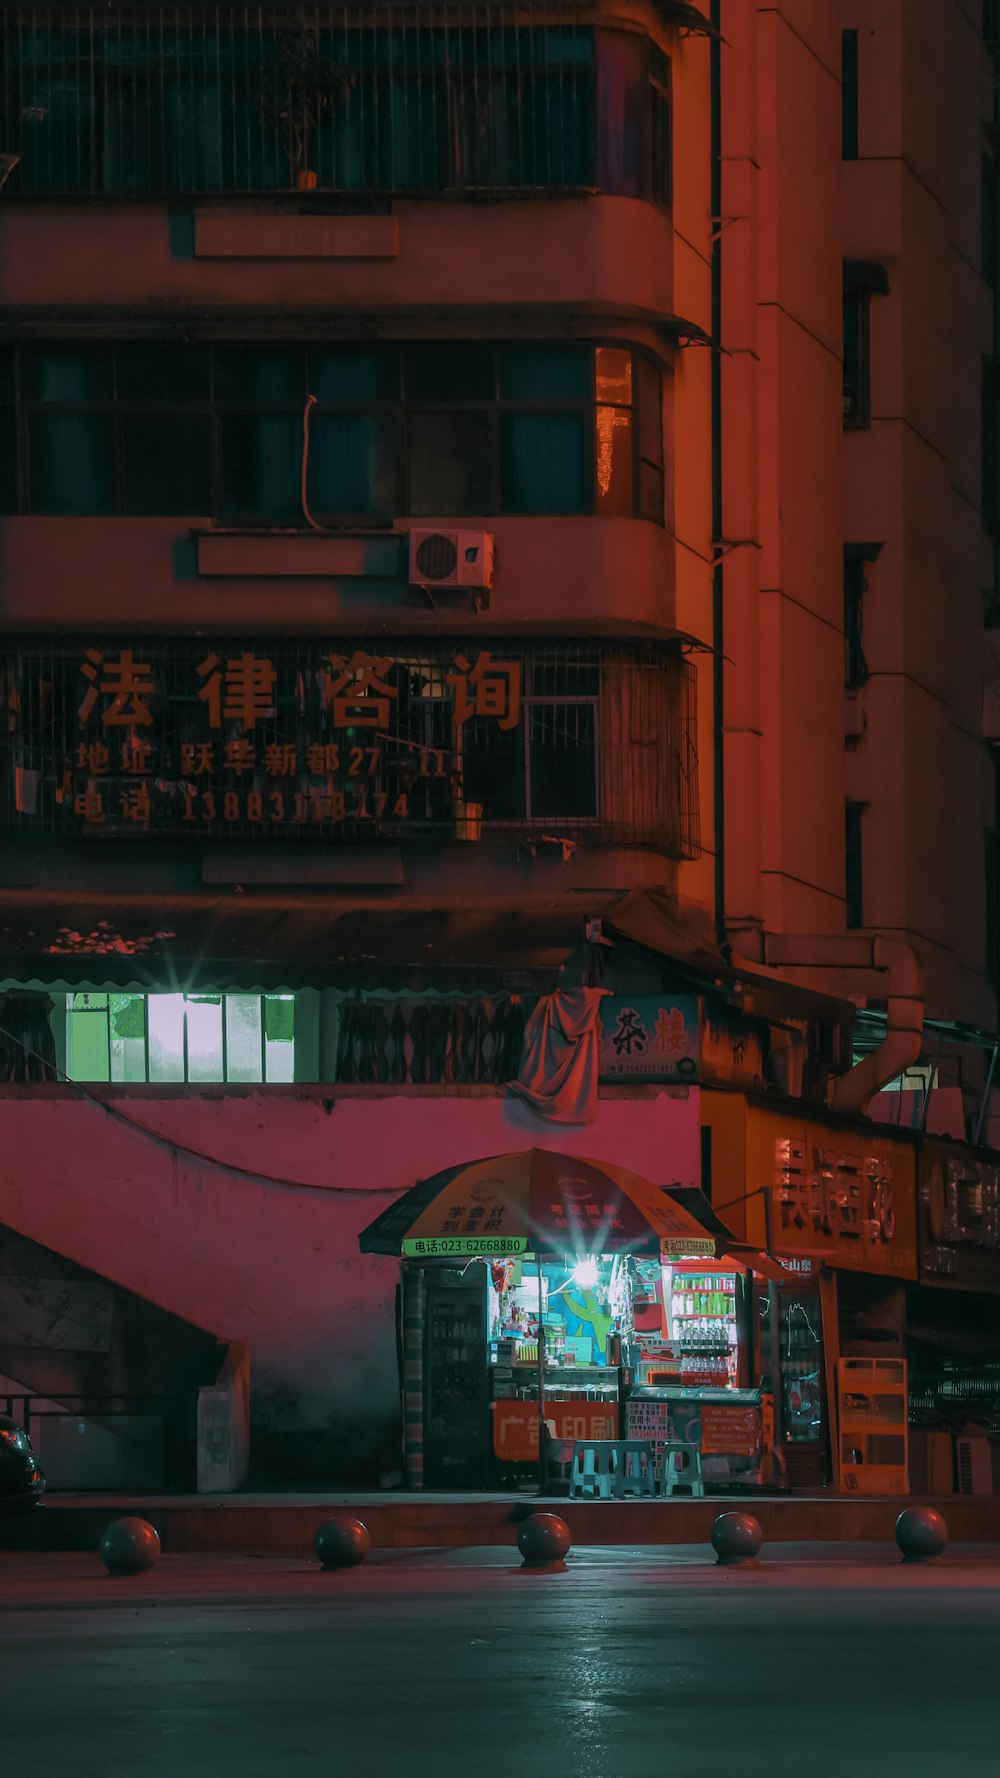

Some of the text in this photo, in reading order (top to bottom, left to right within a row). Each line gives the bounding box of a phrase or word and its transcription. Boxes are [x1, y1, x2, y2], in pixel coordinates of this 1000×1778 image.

[77, 647, 523, 732] 法律咨询
[596, 1008, 688, 1056] 茶楼
[448, 1205, 507, 1218] 学会计
[415, 1240, 521, 1253] 电话:023-62668880
